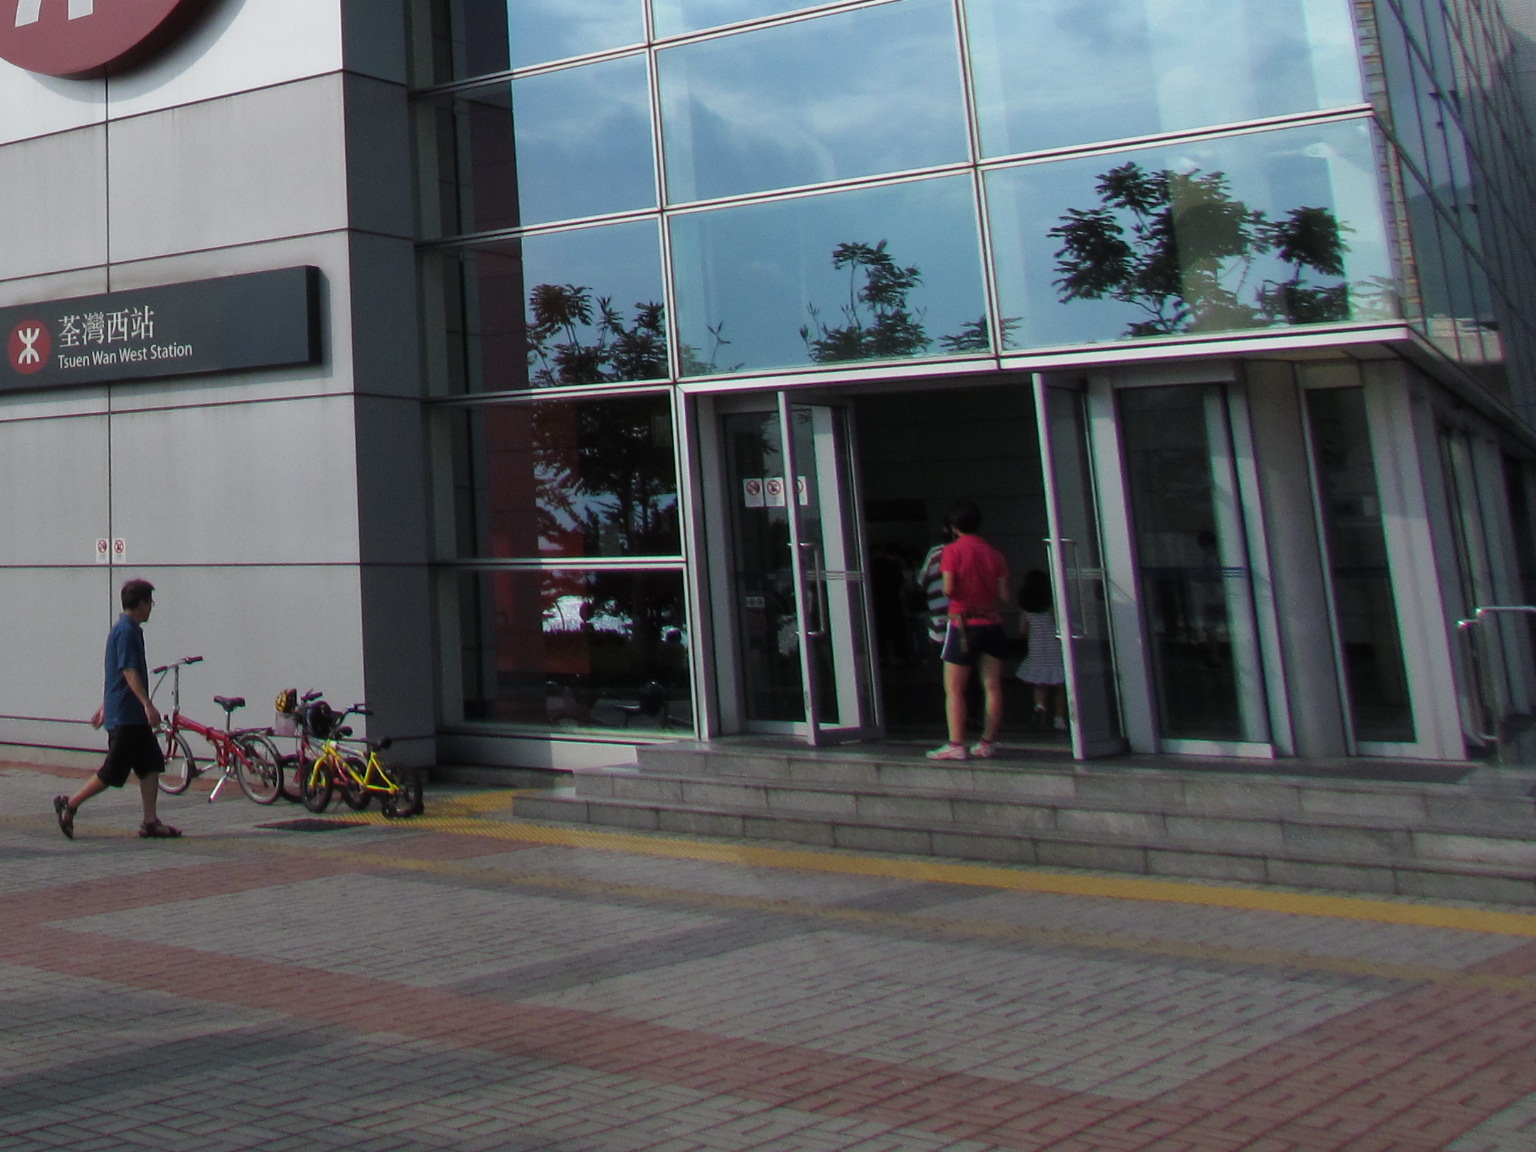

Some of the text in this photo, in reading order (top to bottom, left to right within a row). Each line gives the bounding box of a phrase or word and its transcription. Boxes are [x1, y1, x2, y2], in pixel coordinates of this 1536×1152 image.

[58, 305, 154, 347] 荃灣西站
[57, 342, 193, 369] Tsuen Wan West Station
